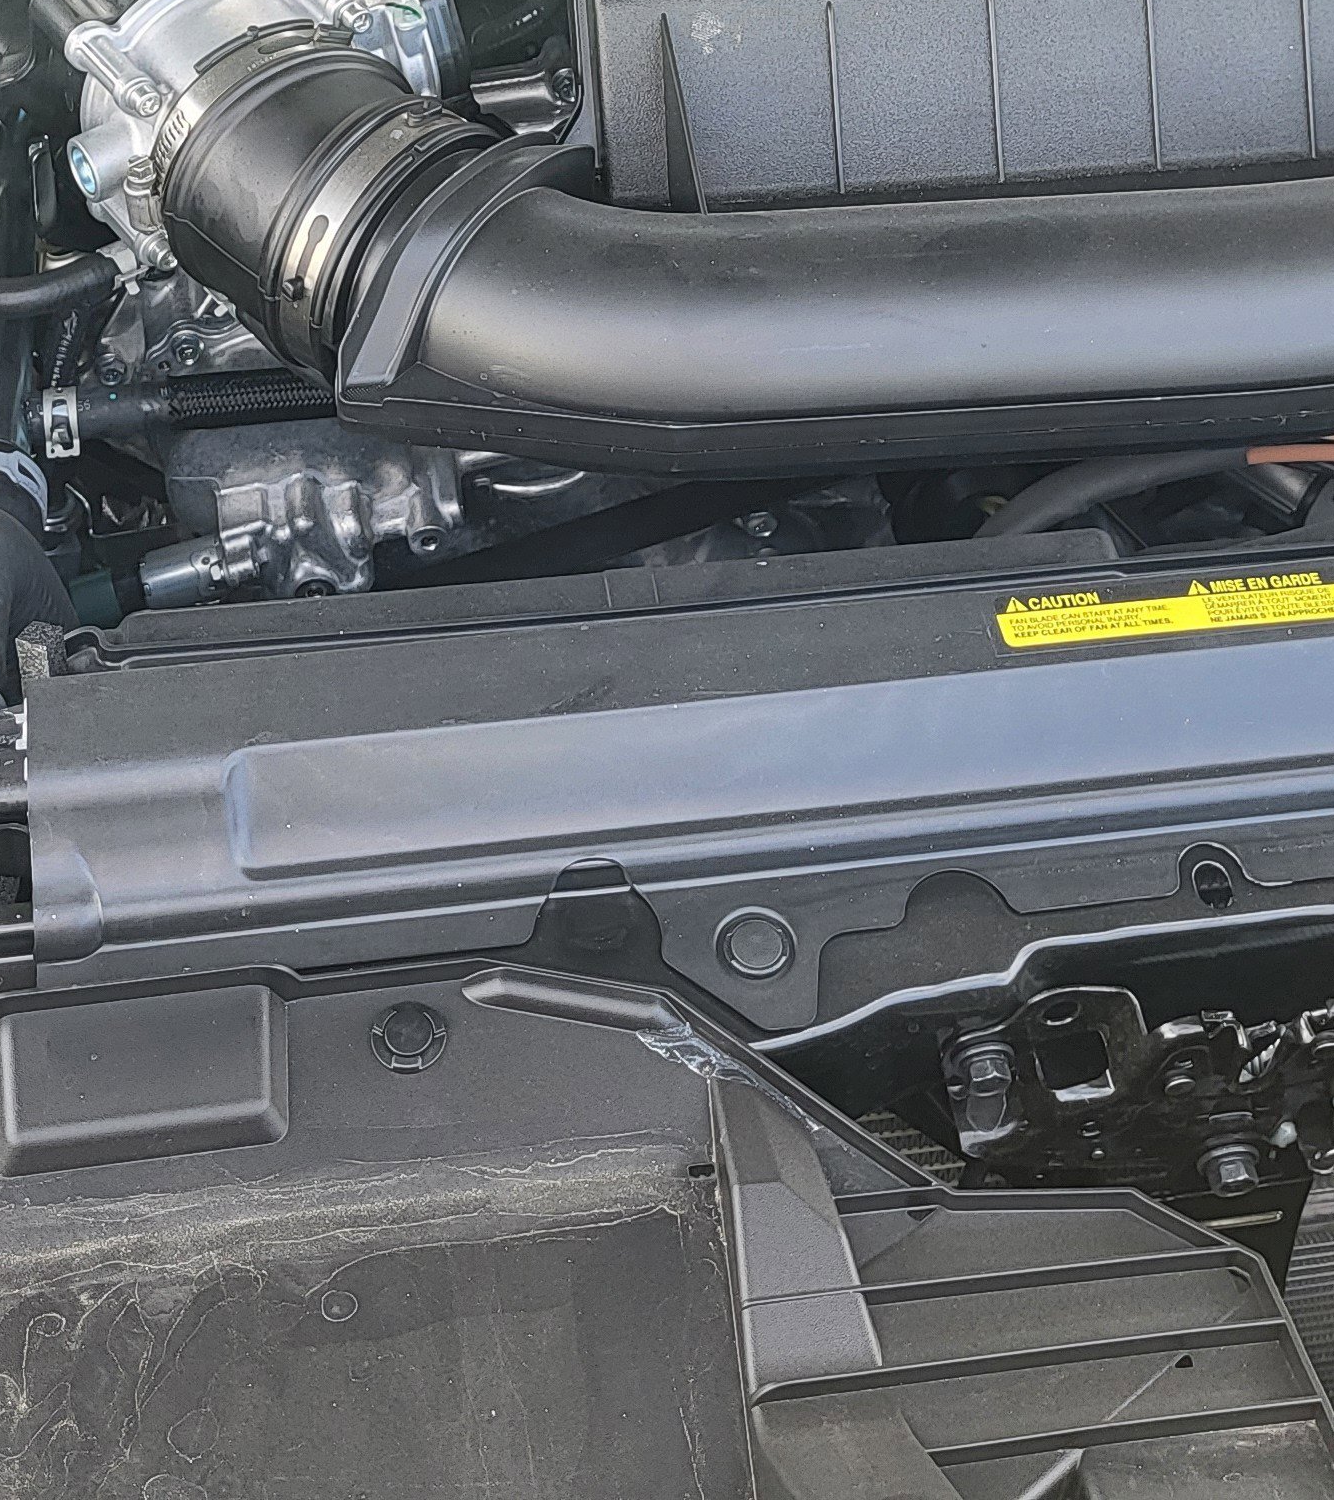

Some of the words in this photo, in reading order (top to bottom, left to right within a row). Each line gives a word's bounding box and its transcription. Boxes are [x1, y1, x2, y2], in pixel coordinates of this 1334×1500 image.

[1210, 579, 1246, 593] MISE
[1247, 576, 1269, 590] EN
[1270, 573, 1322, 588] GARDE
[1028, 592, 1100, 610] CAUTION
[1214, 591, 1278, 602] VENTILATEUR
[1280, 588, 1315, 596] RISQUE
[1030, 615, 1057, 623] BLADE
[1061, 612, 1080, 620] CAN
[1083, 610, 1110, 618] START
[1126, 606, 1143, 614] ANY
[1226, 613, 1258, 621] JAMAIS
[1056, 617, 1104, 627] PERSONAL
[1042, 628, 1072, 636] CLEAR
